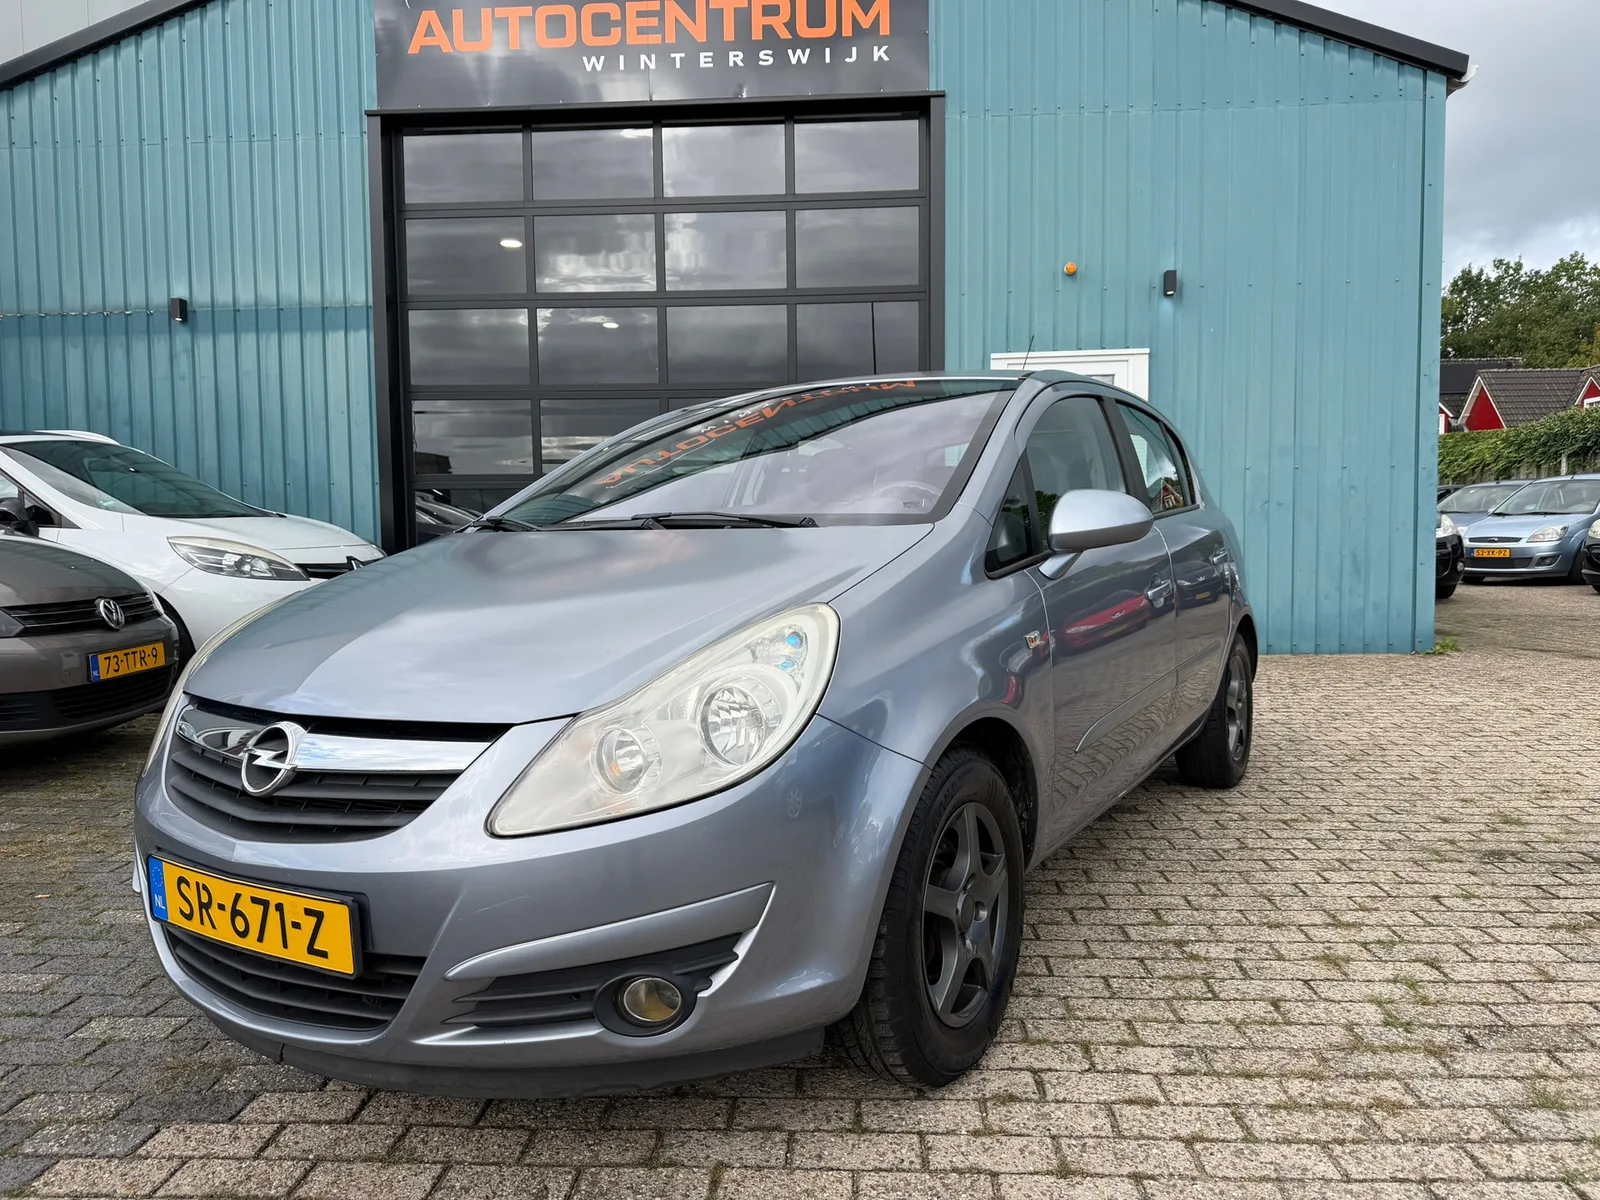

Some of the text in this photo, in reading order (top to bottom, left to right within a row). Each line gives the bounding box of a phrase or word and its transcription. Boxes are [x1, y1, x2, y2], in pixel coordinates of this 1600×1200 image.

[407, 0, 891, 54] AUTOCENTRUM
[582, 45, 890, 72] WINTERSWIJK
[103, 646, 158, 675] 73-TTR-9
[154, 893, 166, 910] NL
[176, 875, 329, 960] SR-671-Z
